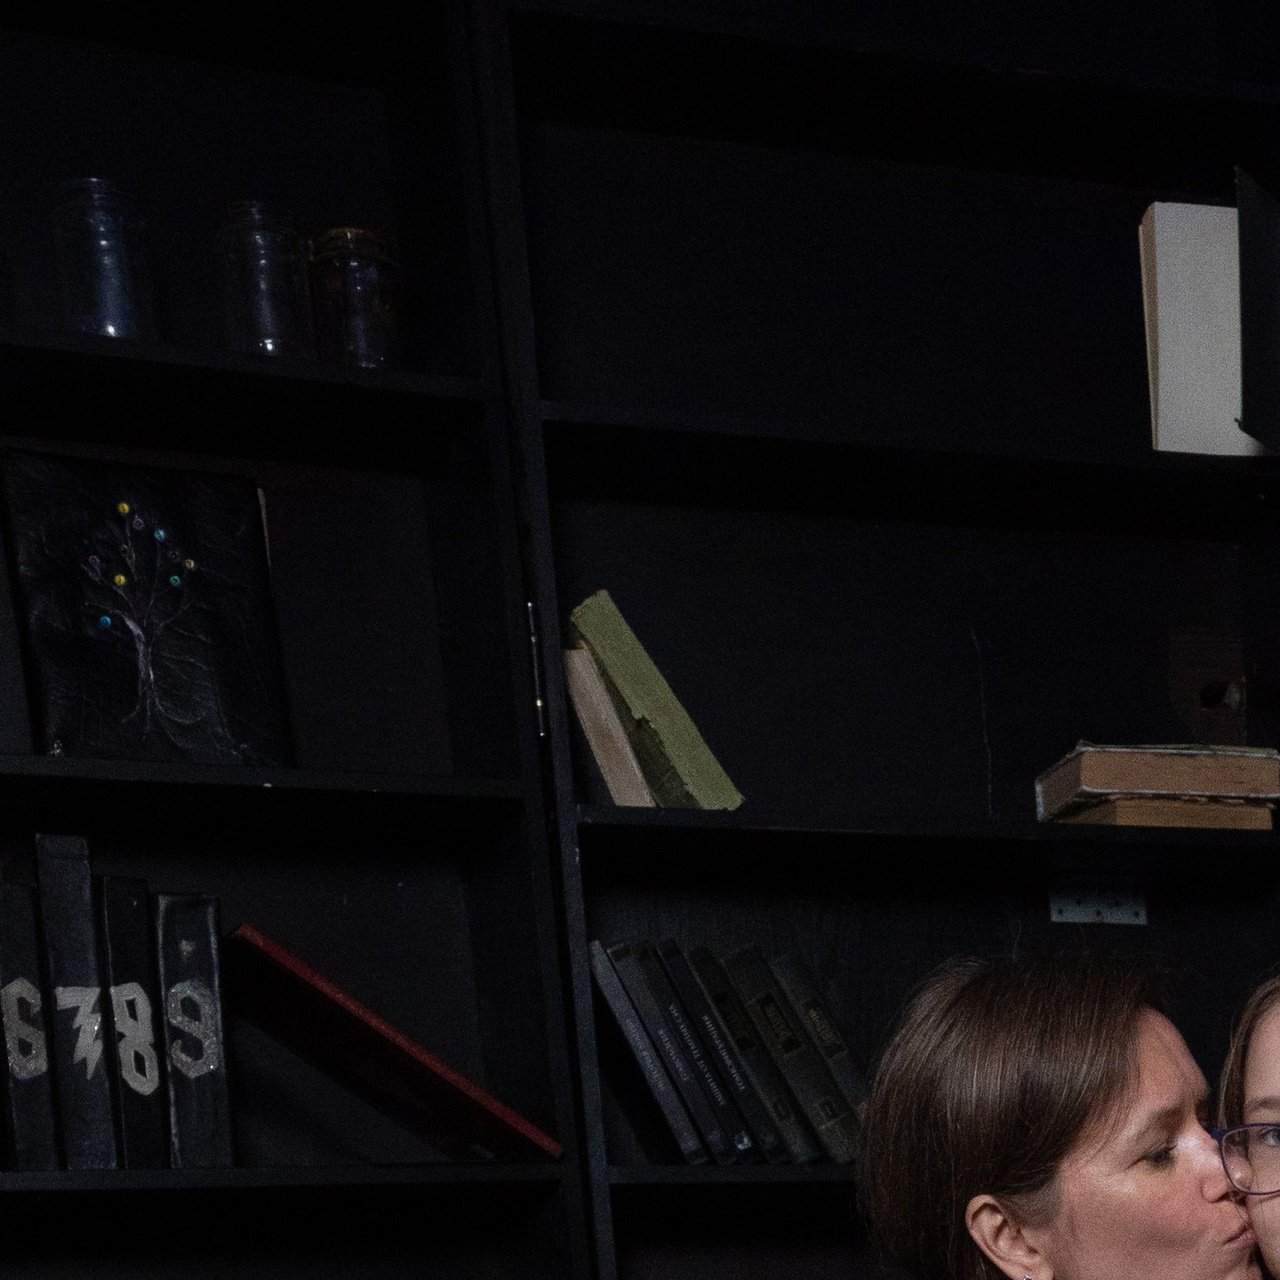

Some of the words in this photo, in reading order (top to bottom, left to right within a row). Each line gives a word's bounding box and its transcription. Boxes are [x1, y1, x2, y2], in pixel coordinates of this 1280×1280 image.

[0, 977, 48, 1080] 6
[55, 986, 104, 1081] 7
[110, 981, 160, 1096] 8
[168, 977, 219, 1079] 9
